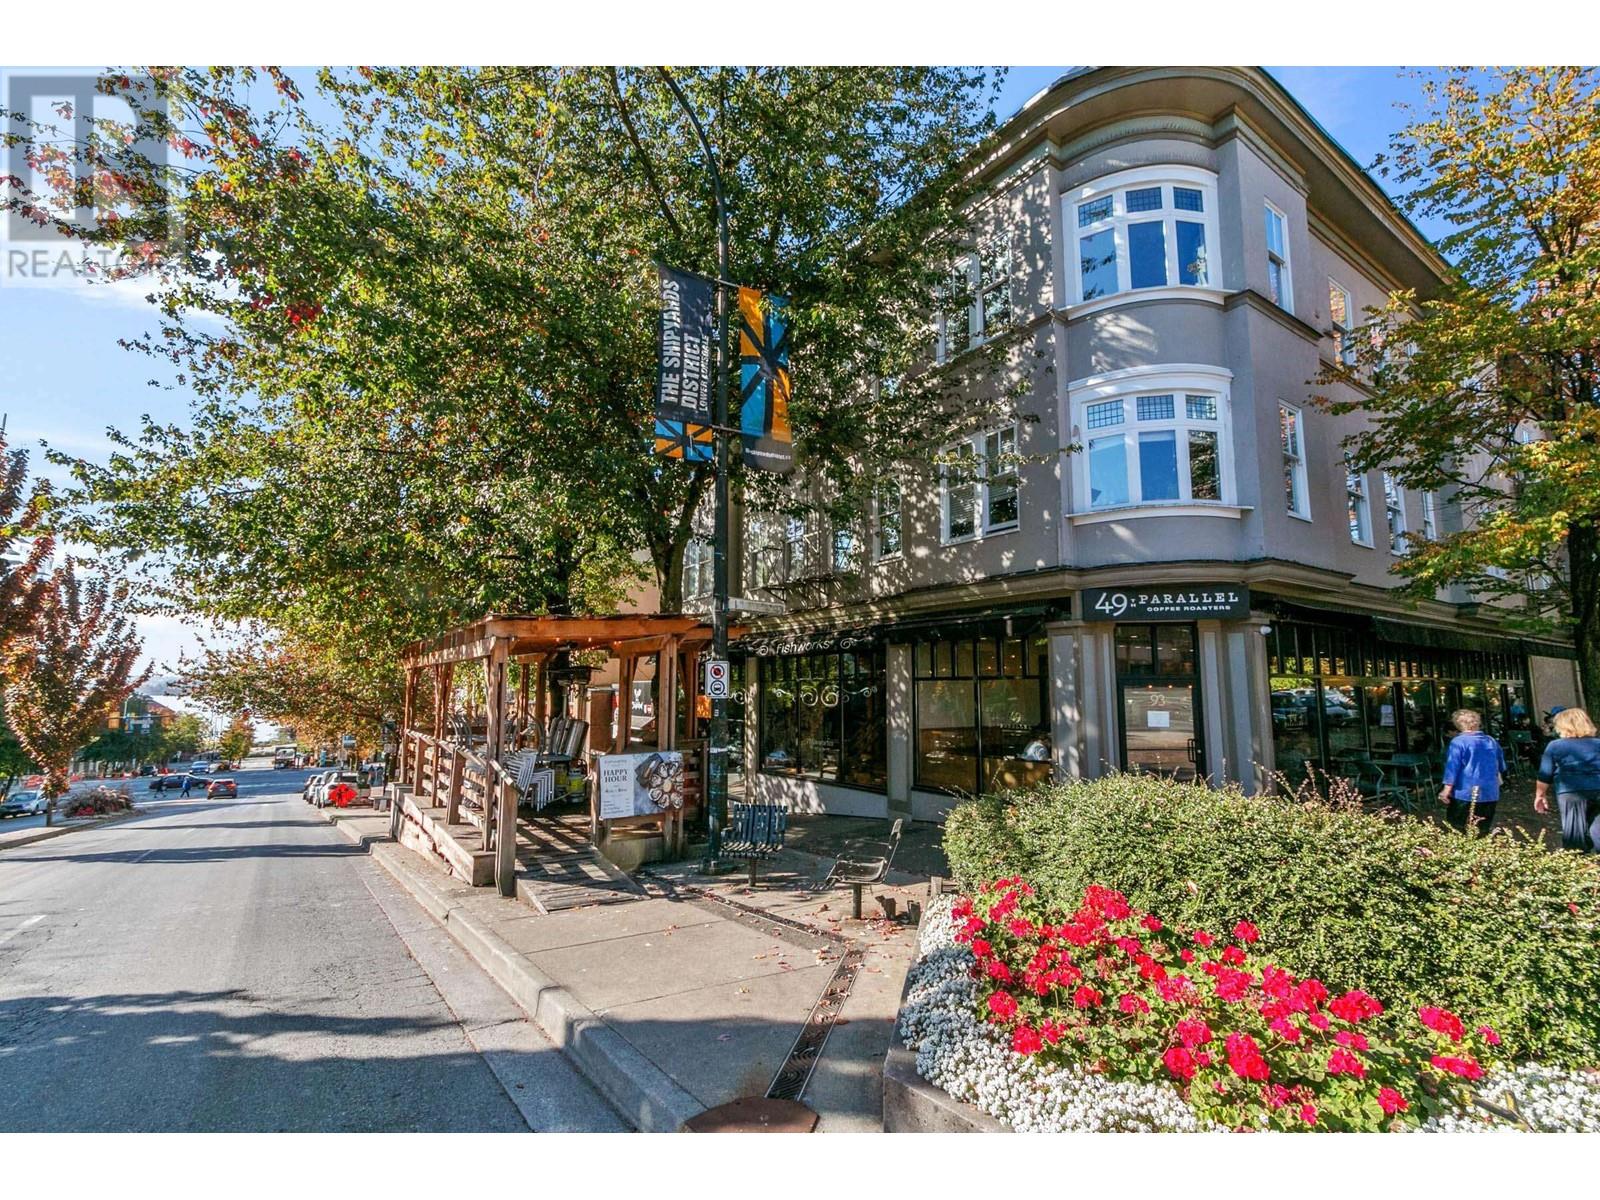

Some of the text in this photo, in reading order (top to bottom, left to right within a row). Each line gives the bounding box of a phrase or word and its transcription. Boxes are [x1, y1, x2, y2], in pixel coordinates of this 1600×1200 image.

[661, 280, 680, 403] THE SHIPYARDS
[681, 333, 701, 409] DISTRICT
[699, 380, 708, 411] LOWER
[1138, 592, 1239, 604] PARALLEL
[776, 640, 830, 655] fishworks
[1150, 694, 1166, 706] 93
[603, 769, 628, 777] HAPPY
[604, 775, 628, 783] HOUR
